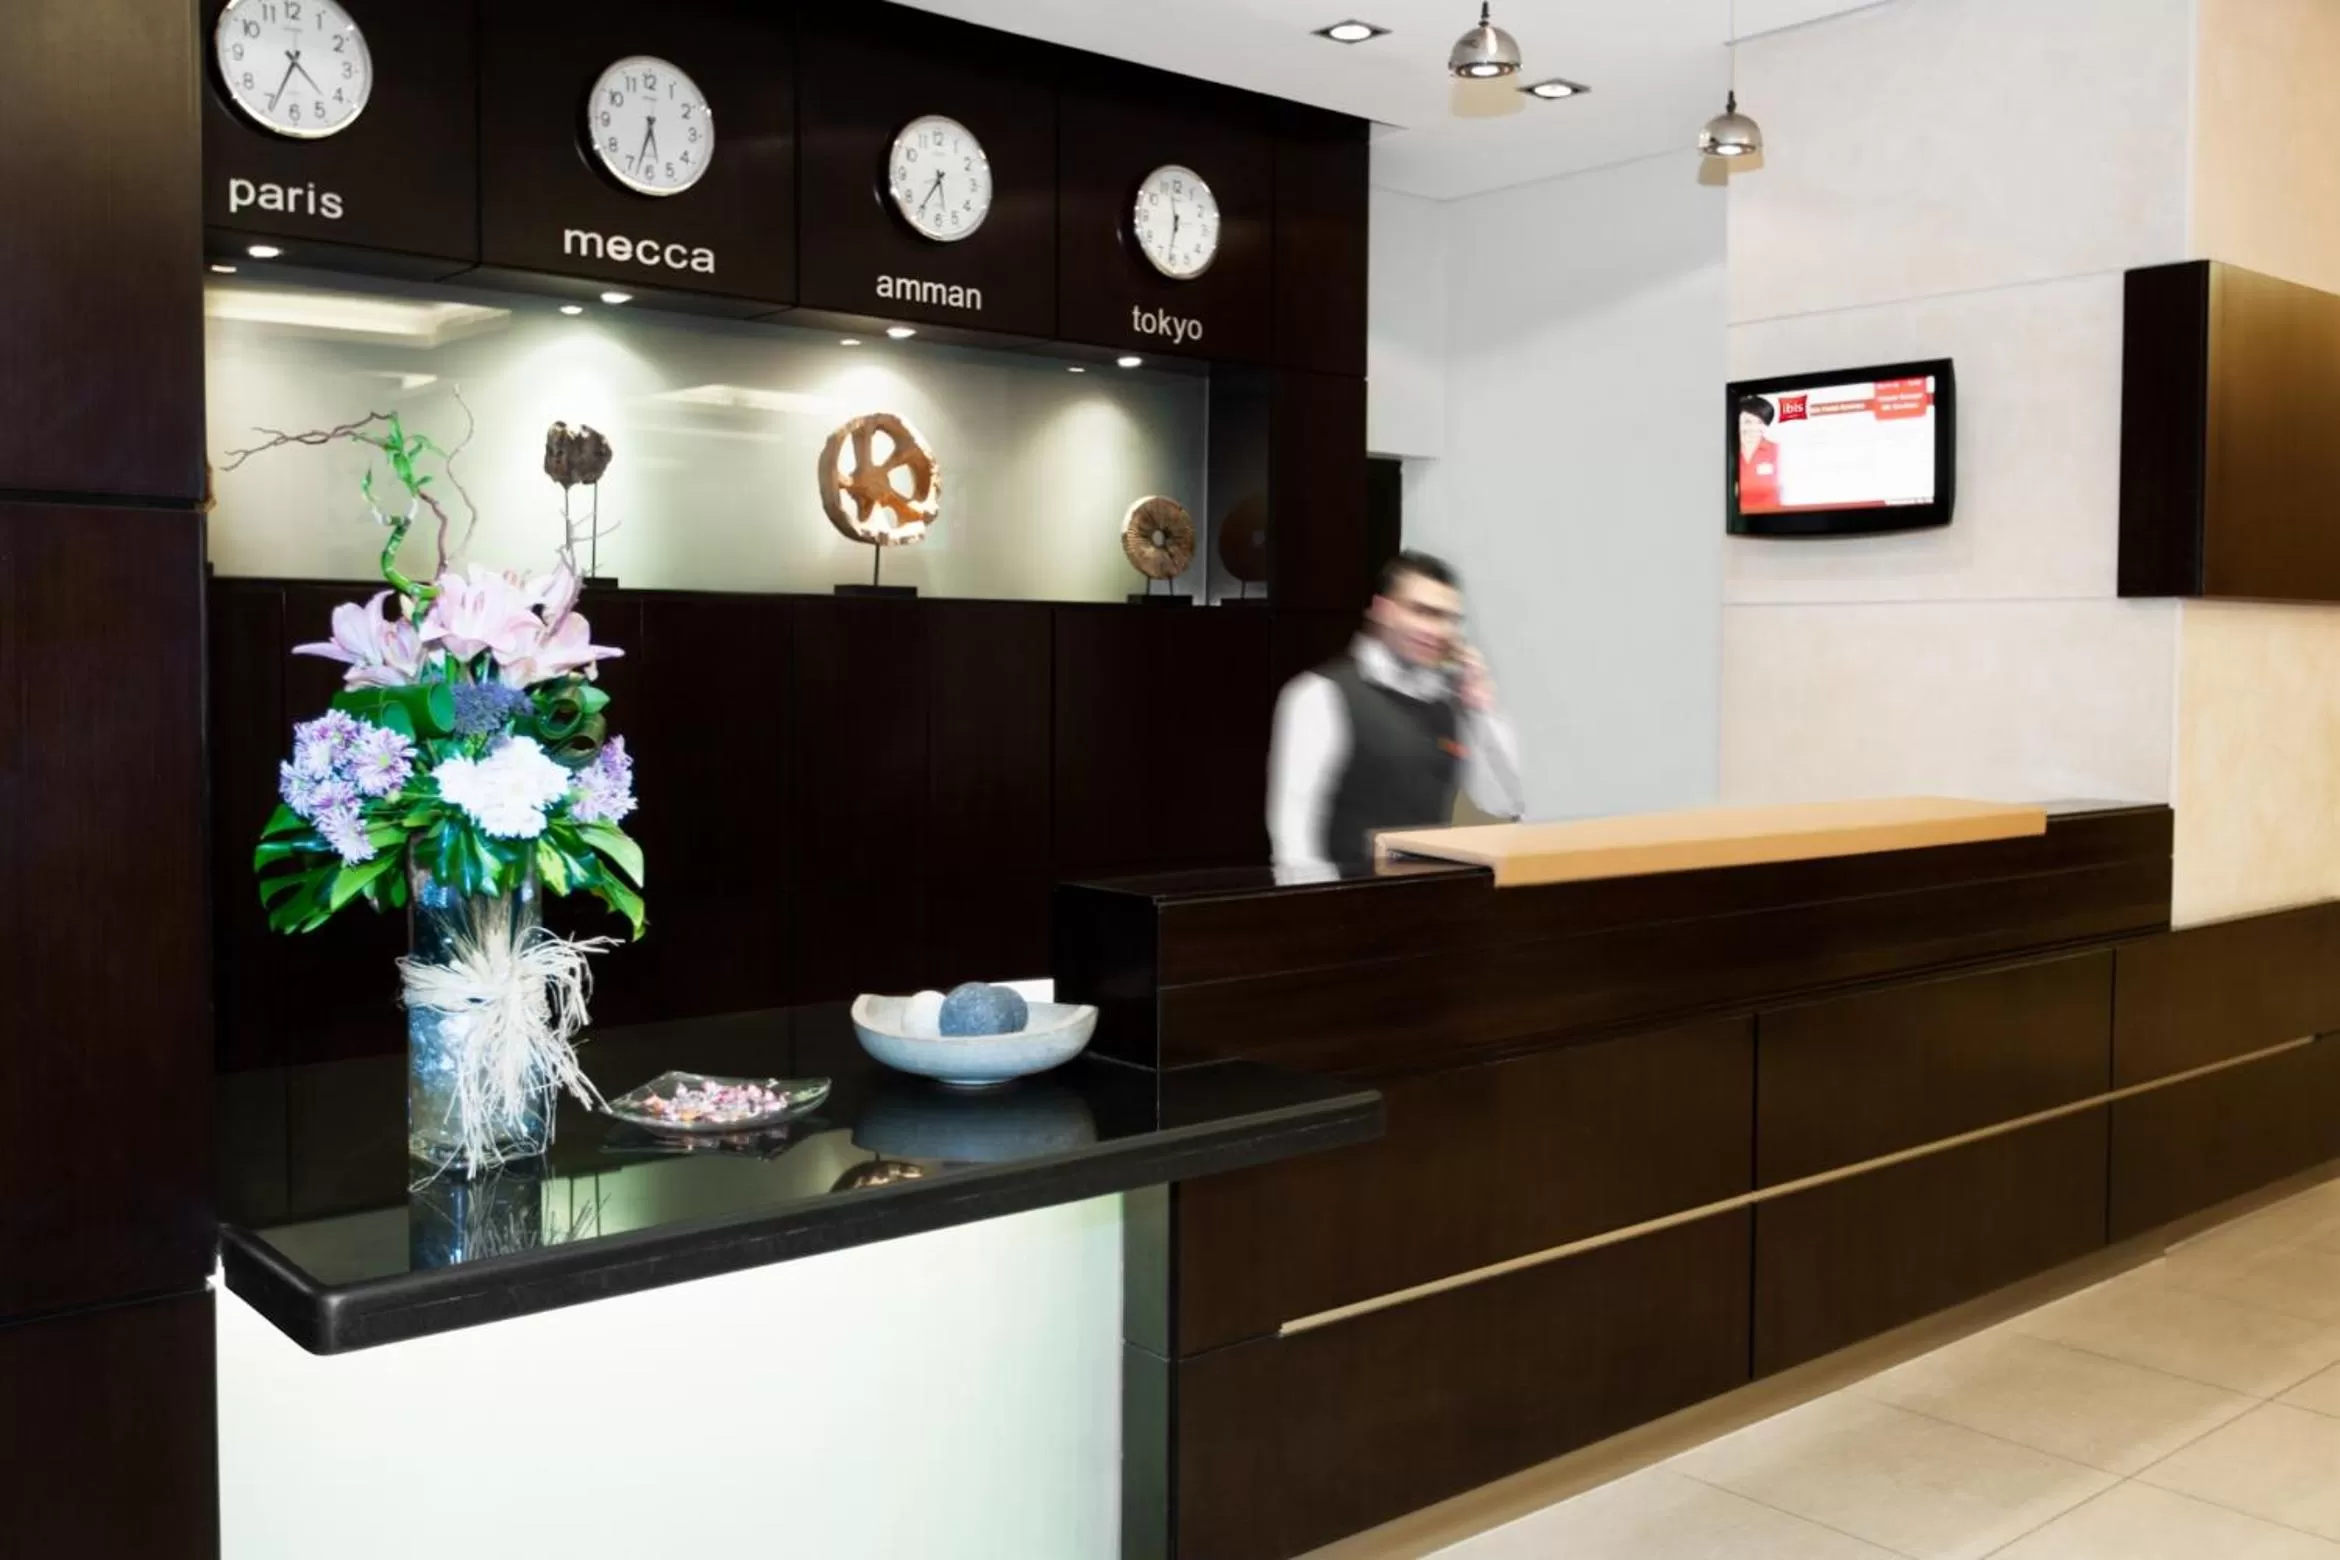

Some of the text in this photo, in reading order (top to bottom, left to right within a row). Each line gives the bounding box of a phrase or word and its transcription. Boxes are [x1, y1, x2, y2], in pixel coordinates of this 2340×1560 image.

[262, 4, 276, 24] 11
[285, 1, 301, 20] 12
[243, 19, 260, 38] 10
[316, 12, 323, 31] 1
[232, 43, 244, 60] 9
[332, 34, 344, 53] 2
[342, 61, 352, 79] 3
[242, 72, 254, 90] 8
[625, 76, 637, 92] 11
[642, 72, 657, 91] 12
[332, 87, 343, 104] 4
[609, 89, 624, 108] 10
[669, 83, 674, 100] 1
[289, 103, 301, 121] 6
[315, 101, 325, 119] 5
[601, 111, 611, 127] 9
[681, 103, 692, 120] 2
[688, 126, 697, 143] 3
[608, 137, 618, 153] 8
[625, 154, 635, 170] 7
[680, 150, 689, 165] 4
[645, 164, 655, 180] 6
[665, 162, 675, 178] 5
[229, 178, 344, 219] paris
[563, 228, 715, 274] mecca
[876, 275, 982, 310] amman
[1132, 305, 1203, 344] tokyo
[1782, 401, 1804, 414] ibis
